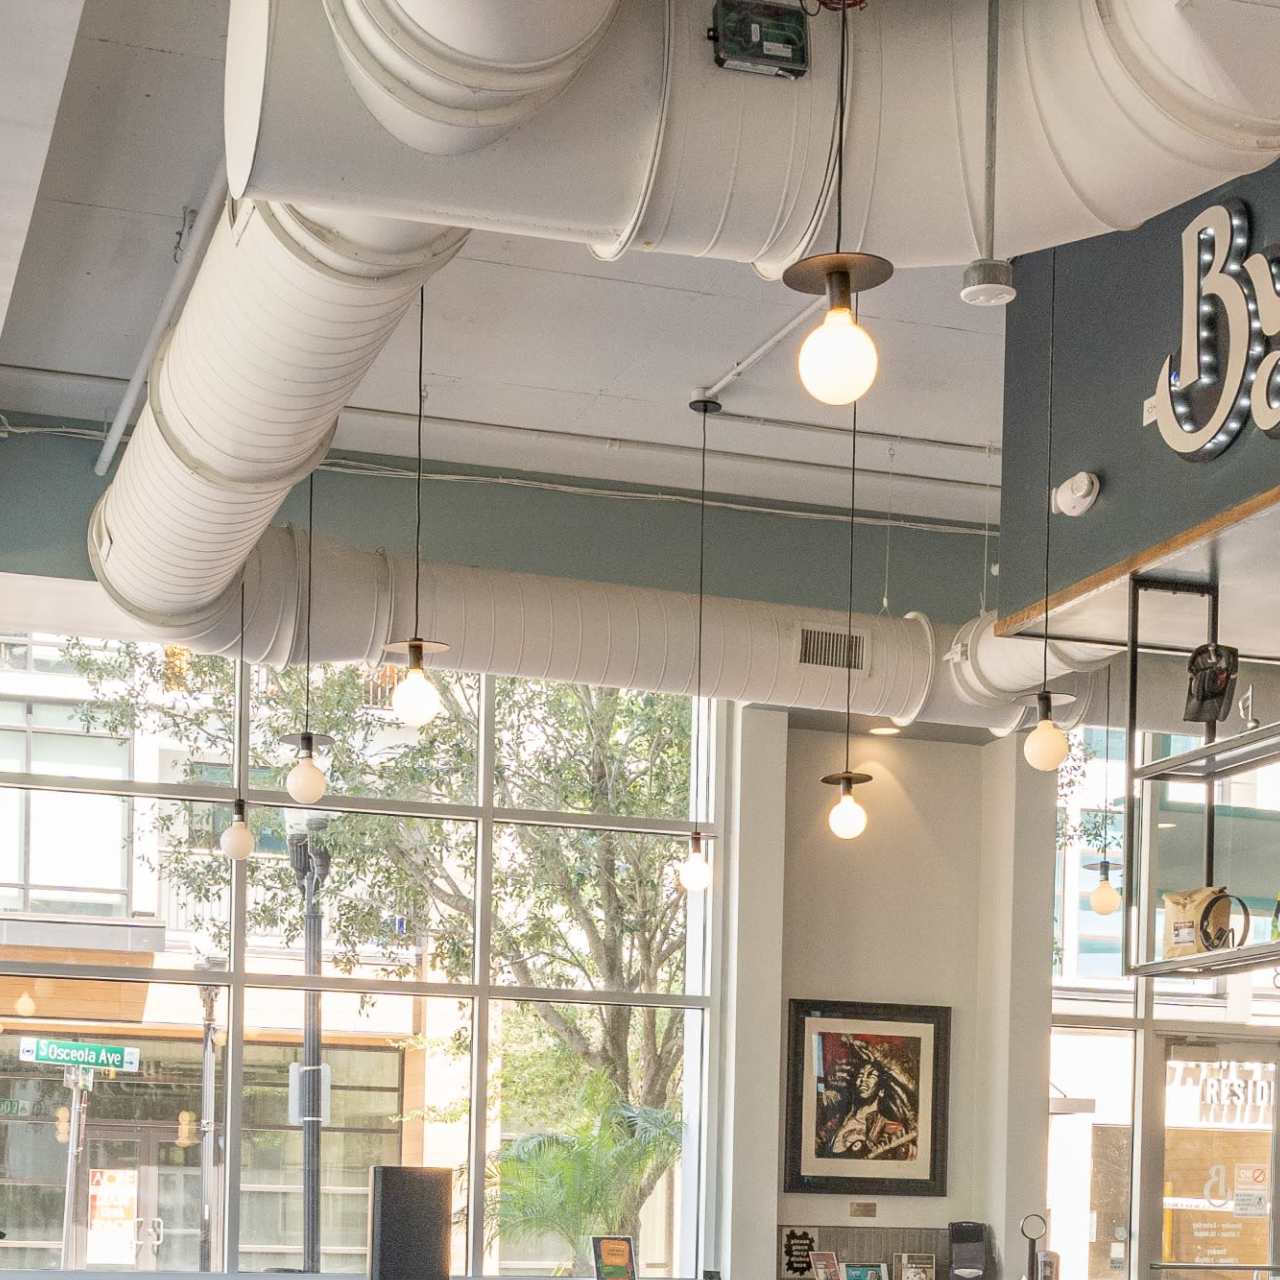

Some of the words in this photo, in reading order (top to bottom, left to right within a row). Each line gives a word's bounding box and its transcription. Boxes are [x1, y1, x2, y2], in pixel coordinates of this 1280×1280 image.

[38, 1039, 49, 1057] S
[48, 1043, 97, 1064] Osceola
[98, 1049, 122, 1066] Ave
